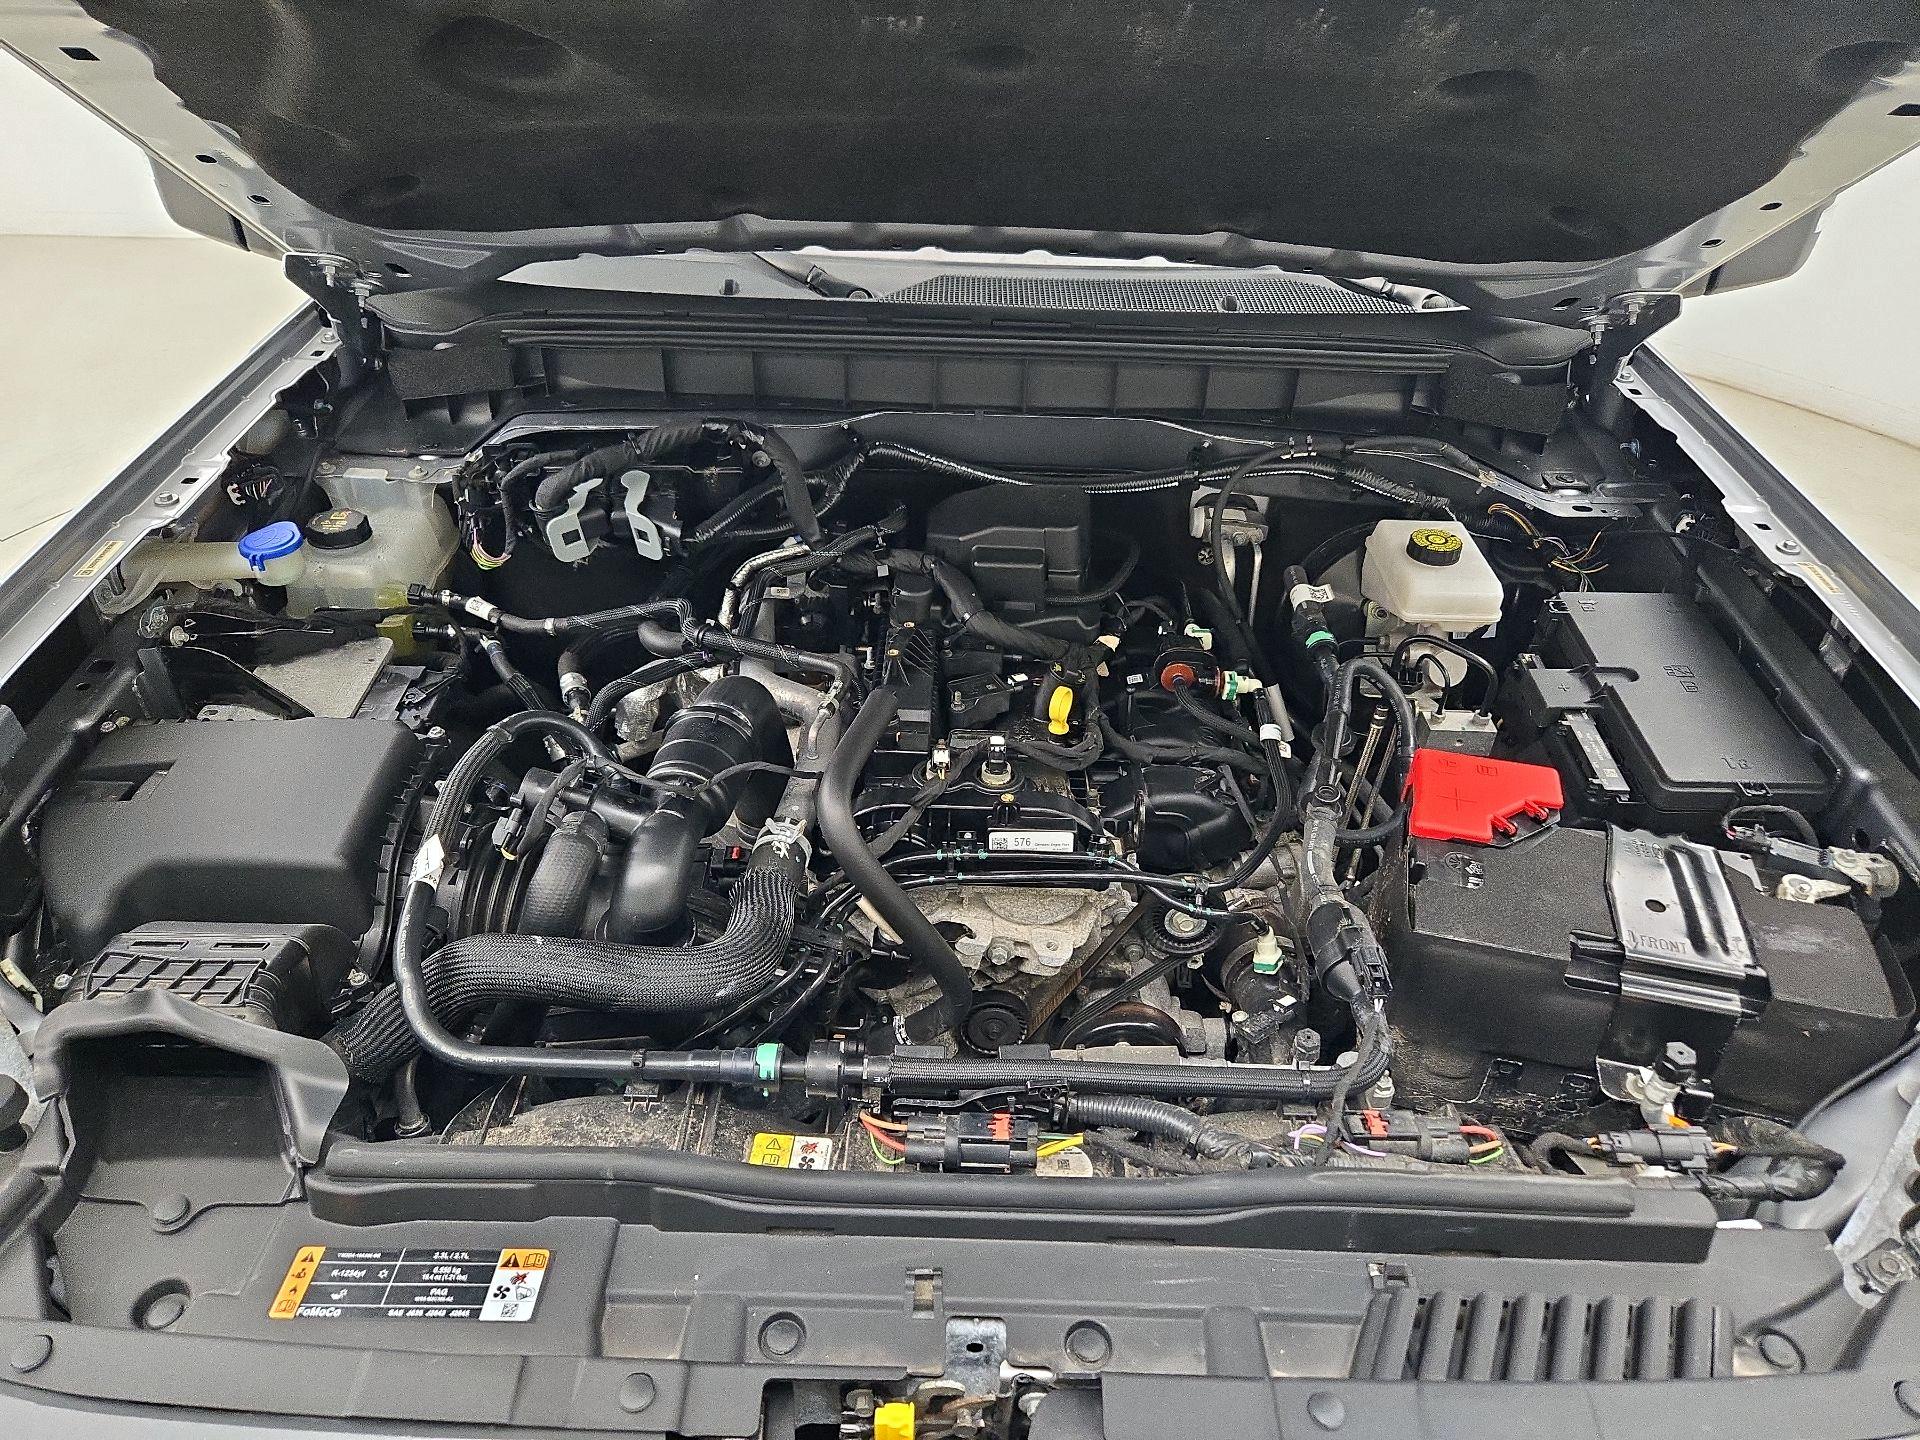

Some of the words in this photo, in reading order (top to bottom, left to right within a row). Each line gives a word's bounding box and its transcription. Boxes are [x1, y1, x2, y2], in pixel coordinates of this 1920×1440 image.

[1014, 837, 1031, 846] 576
[1640, 934, 1686, 954] FRONT
[429, 1288, 448, 1296] PAG
[296, 1306, 341, 1317] FoMoCo
